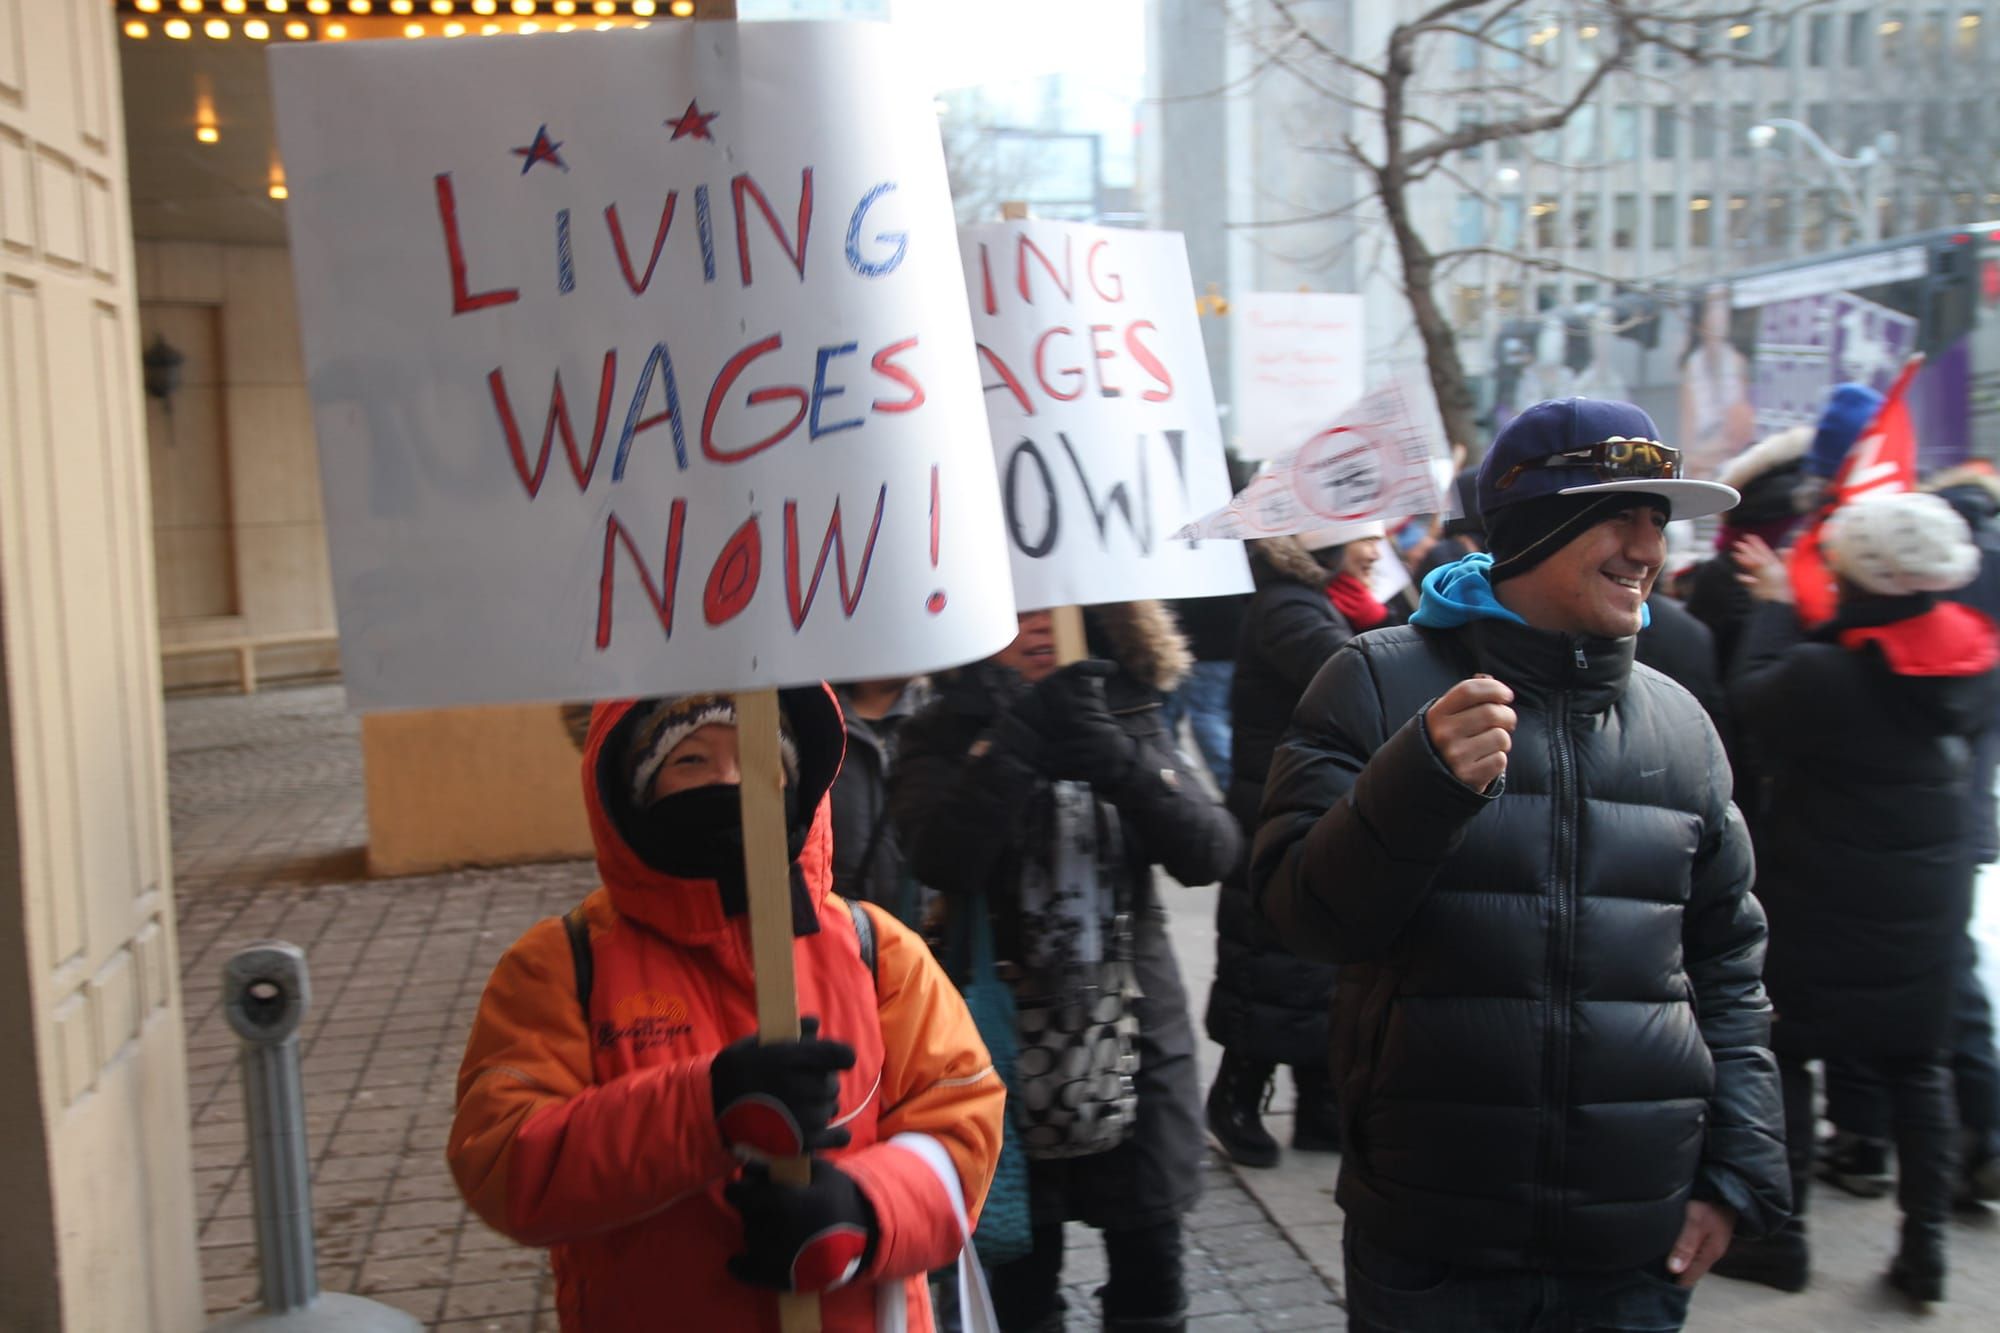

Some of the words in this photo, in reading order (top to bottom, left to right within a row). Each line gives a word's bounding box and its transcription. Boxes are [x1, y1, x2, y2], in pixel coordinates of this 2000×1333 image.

[978, 231, 1125, 316] ING
[488, 333, 926, 500] WAGES
[975, 319, 1176, 417] AGES
[1004, 429, 1200, 559] OW!
